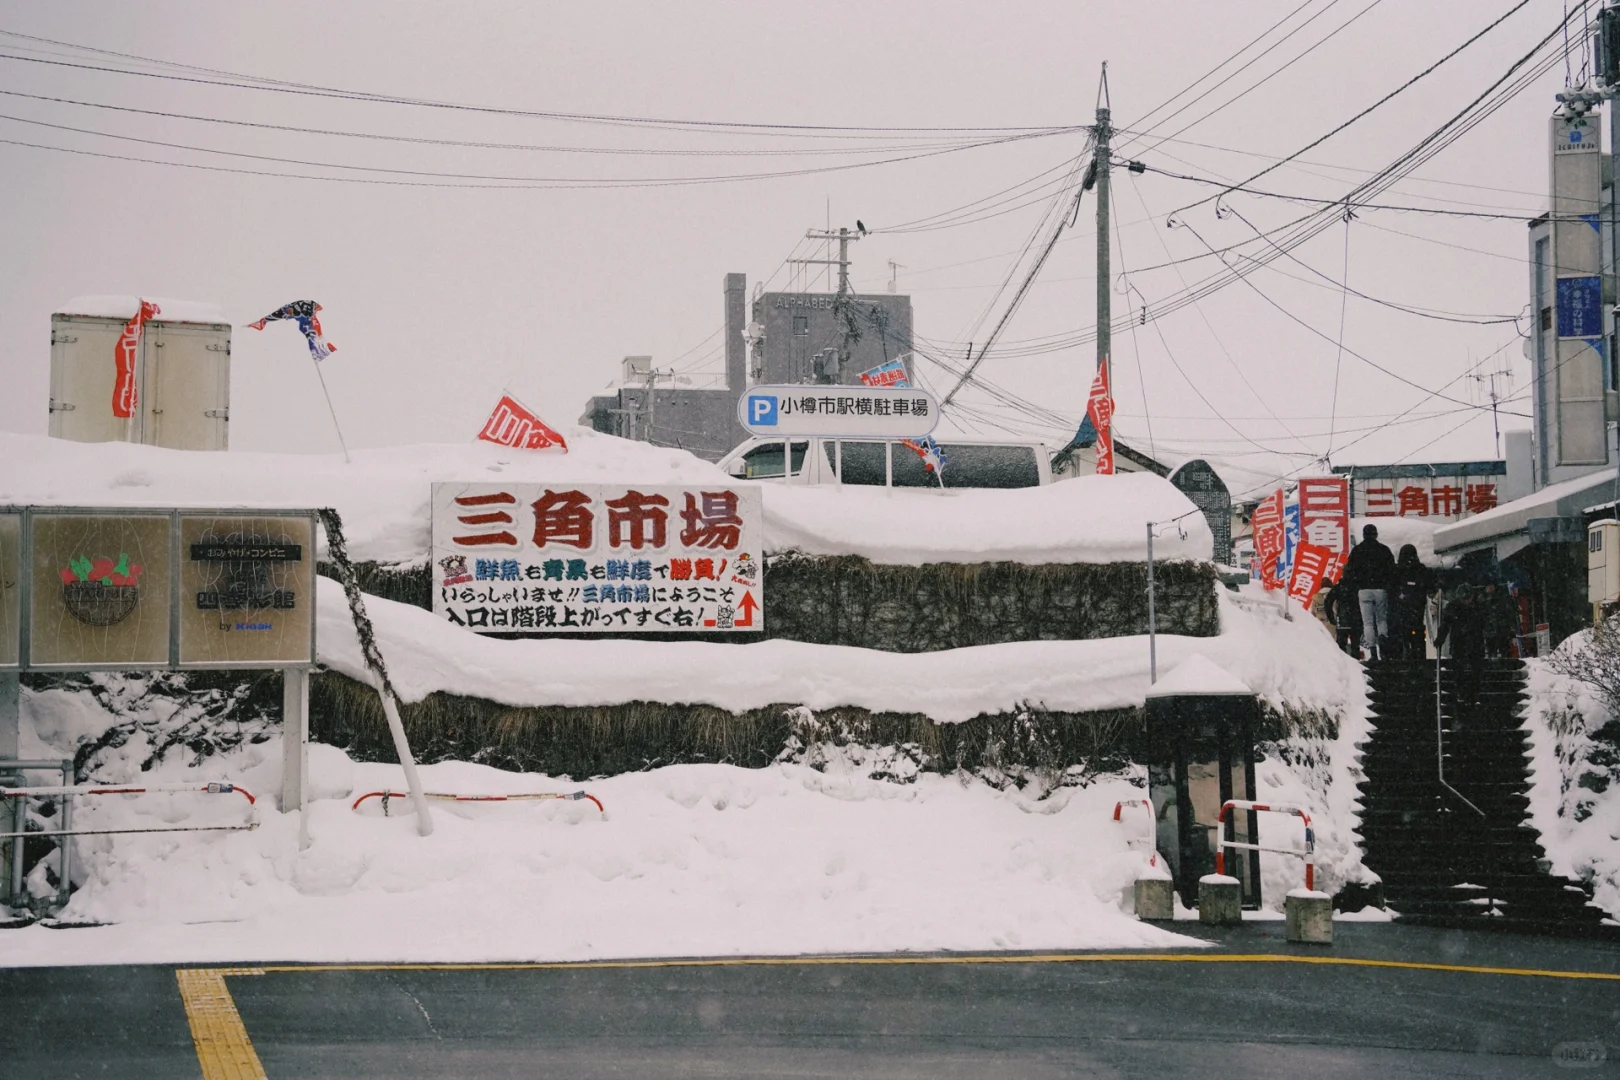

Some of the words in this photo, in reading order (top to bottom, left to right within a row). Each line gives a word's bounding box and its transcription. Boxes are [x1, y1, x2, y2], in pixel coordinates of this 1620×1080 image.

[780, 396, 929, 417] 小樽市駅横駐車場
[1365, 484, 1498, 518] 三角市場
[452, 489, 744, 550] 三角市場
[219, 621, 232, 632] by
[446, 605, 704, 628] 入口は階段上がってすぐ右!
